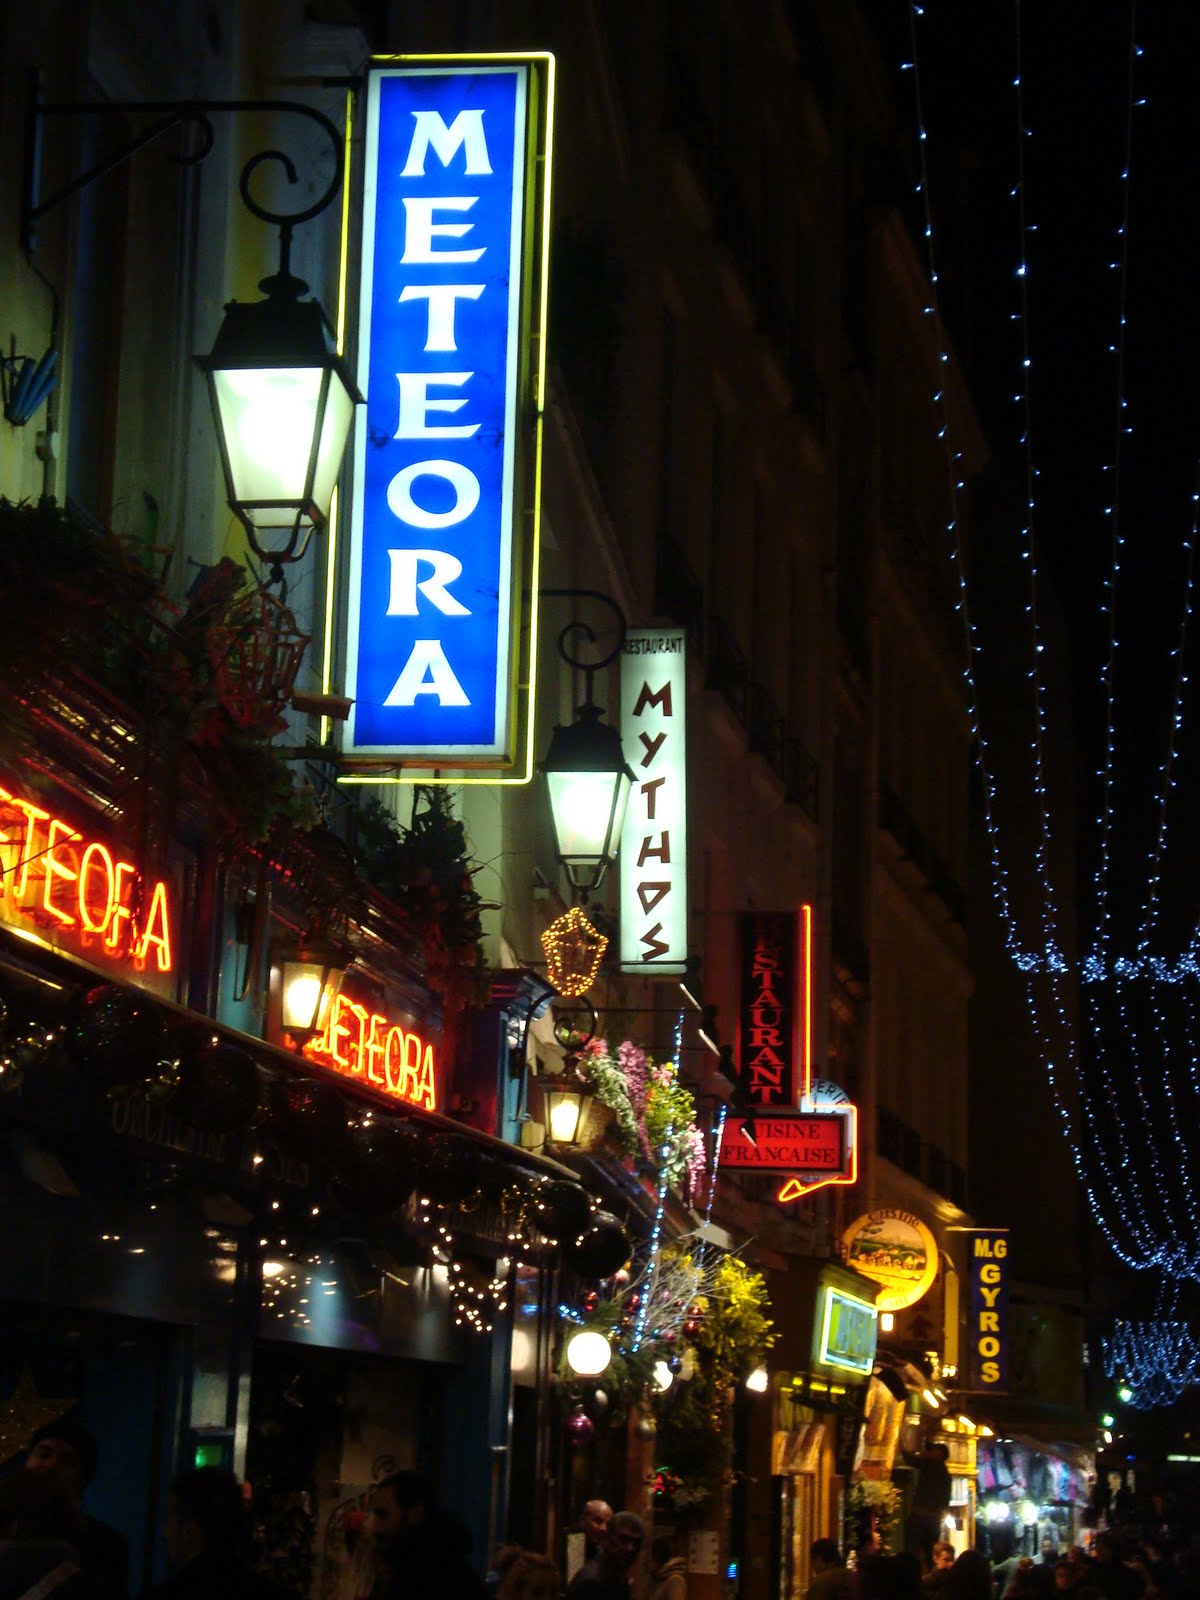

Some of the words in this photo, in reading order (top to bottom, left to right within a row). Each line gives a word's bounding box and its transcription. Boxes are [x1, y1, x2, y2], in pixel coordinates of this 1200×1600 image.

[383, 109, 493, 706] METEORA
[0, 786, 171, 970] TEORA
[633, 681, 672, 962] MYTHOS
[738, 1122, 820, 1140] UISINE
[974, 1238, 1007, 1258] M.G
[978, 1263, 1001, 1383] GYROS
